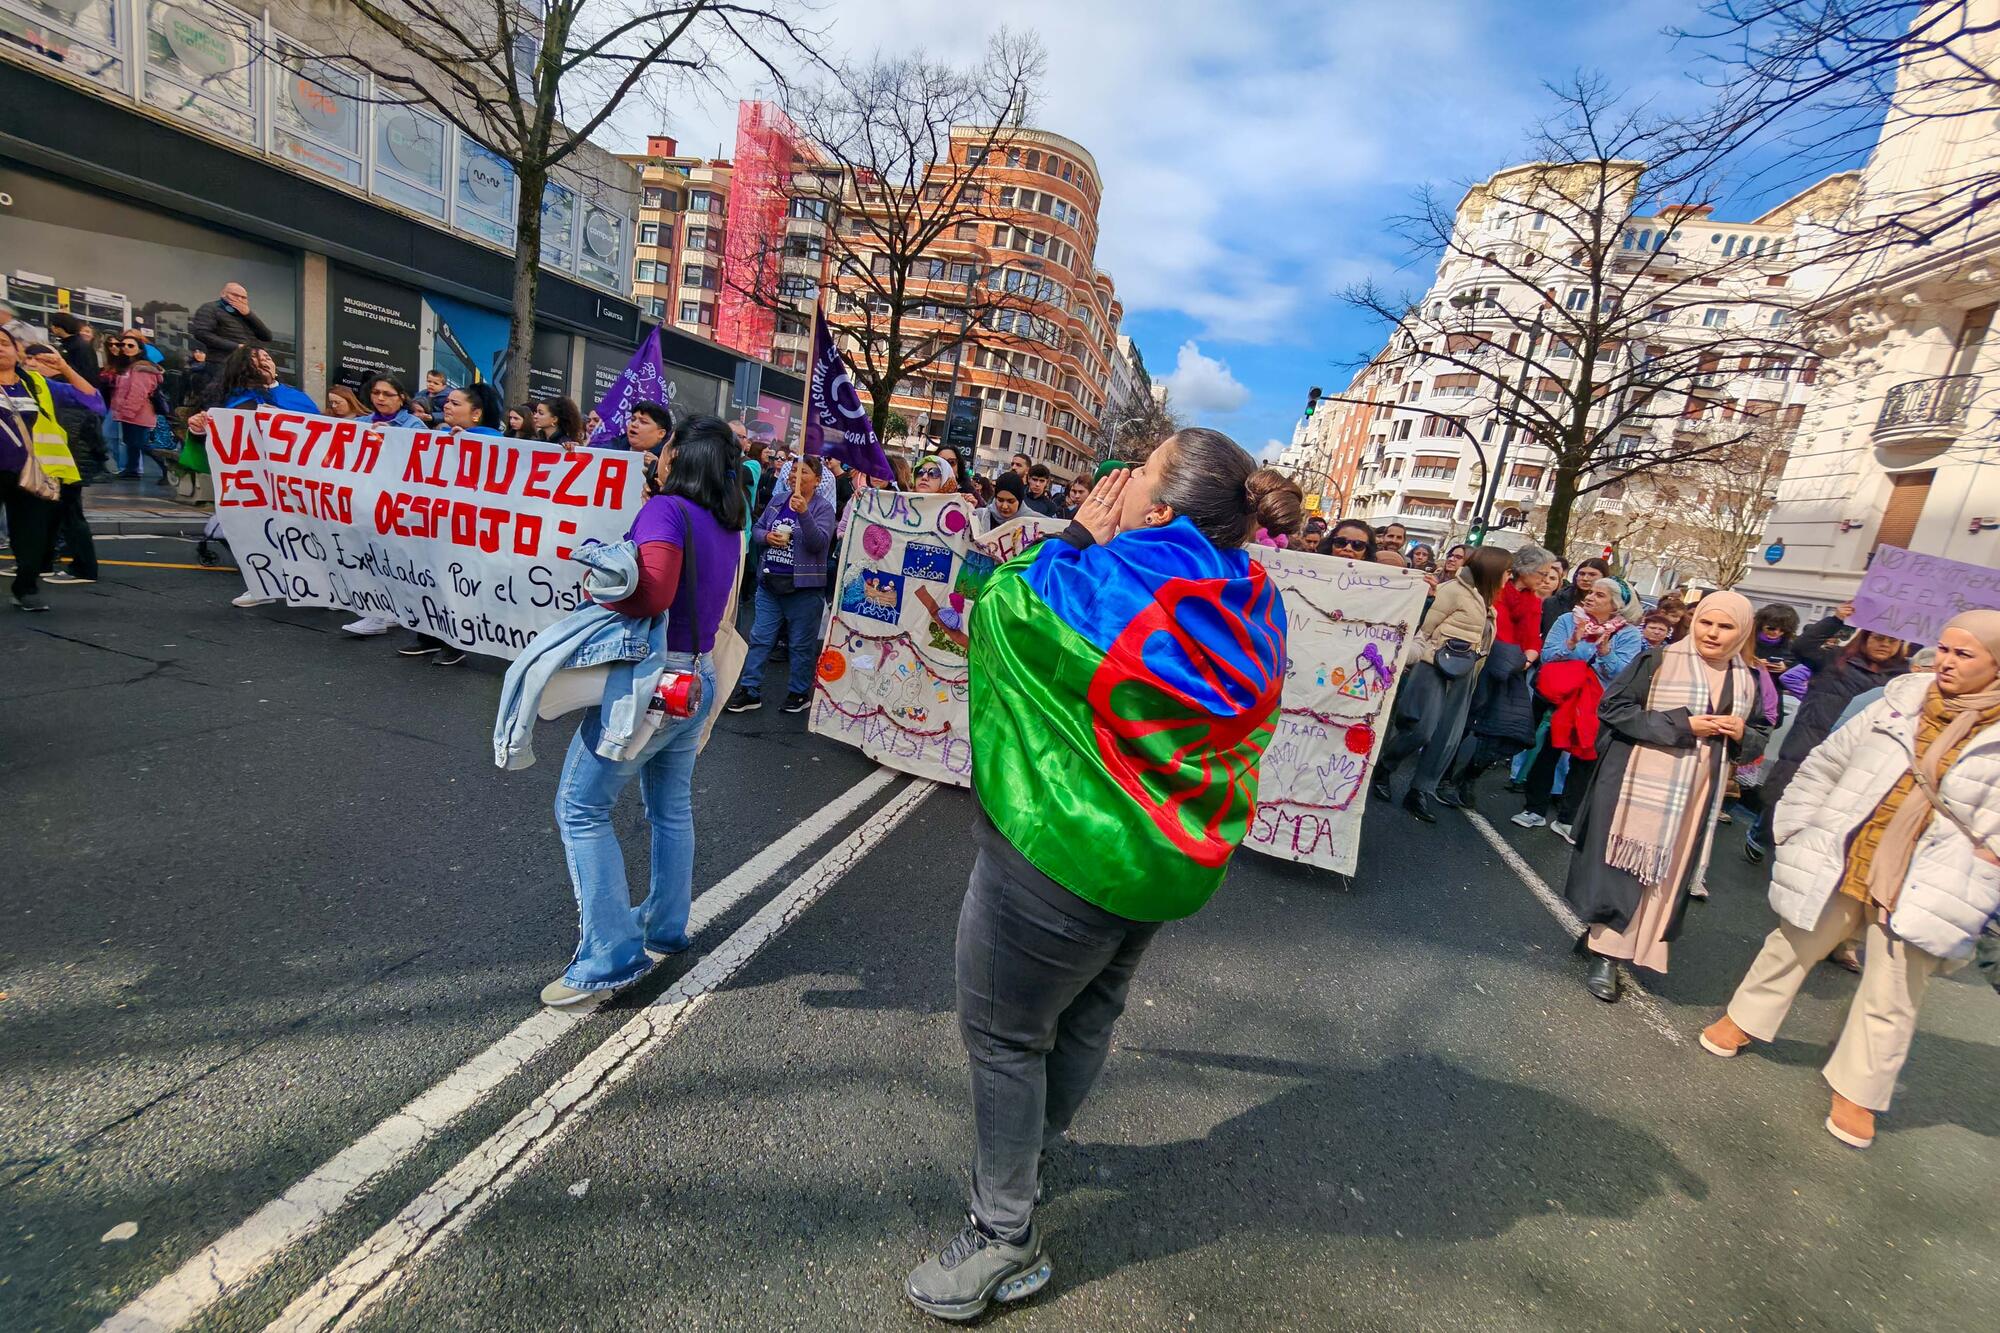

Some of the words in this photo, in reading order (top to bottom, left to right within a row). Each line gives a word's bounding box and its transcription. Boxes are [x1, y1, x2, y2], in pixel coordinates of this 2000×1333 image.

[344, 297, 400, 317] MUGIKORTASUN
[344, 306, 378, 320] ZERBITZU
[379, 315, 416, 330] INTEGRALA
[811, 358, 837, 425] ERASORIK
[827, 344, 839, 363] EZ
[844, 429, 866, 445] GORA
[403, 432, 629, 510] RIQUEZA
[219, 470, 268, 507] ES
[263, 469, 353, 526] ESTRO
[448, 562, 482, 598] Por
[495, 575, 518, 605] el
[528, 565, 582, 612] Sist
[1868, 575, 1913, 601] QUE
[1867, 604, 1938, 641] AVAN
